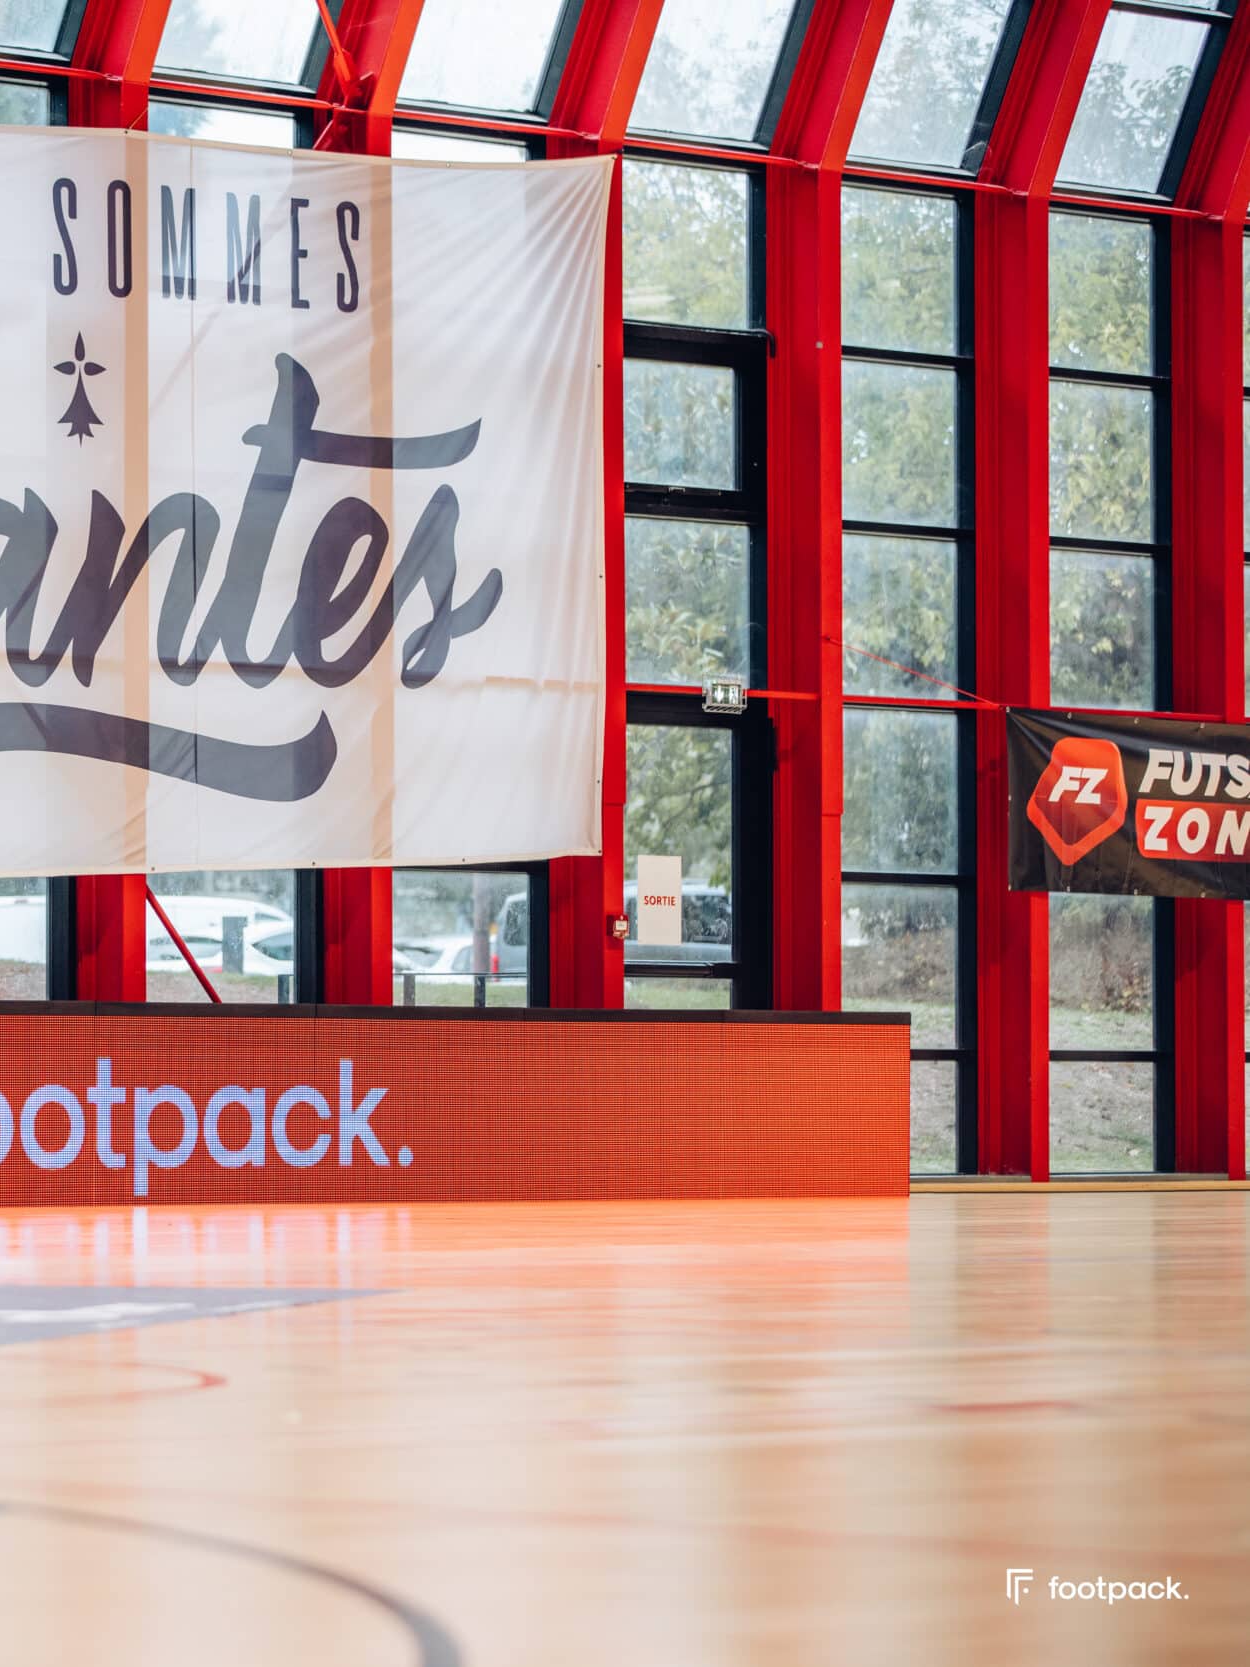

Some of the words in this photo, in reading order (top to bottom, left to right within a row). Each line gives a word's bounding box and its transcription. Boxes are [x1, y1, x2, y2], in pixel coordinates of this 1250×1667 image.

[52, 176, 362, 313] SOMMES
[1048, 765, 1108, 805] FZ
[1138, 748, 1250, 799] FUTS
[643, 895, 676, 906] SORTIE
